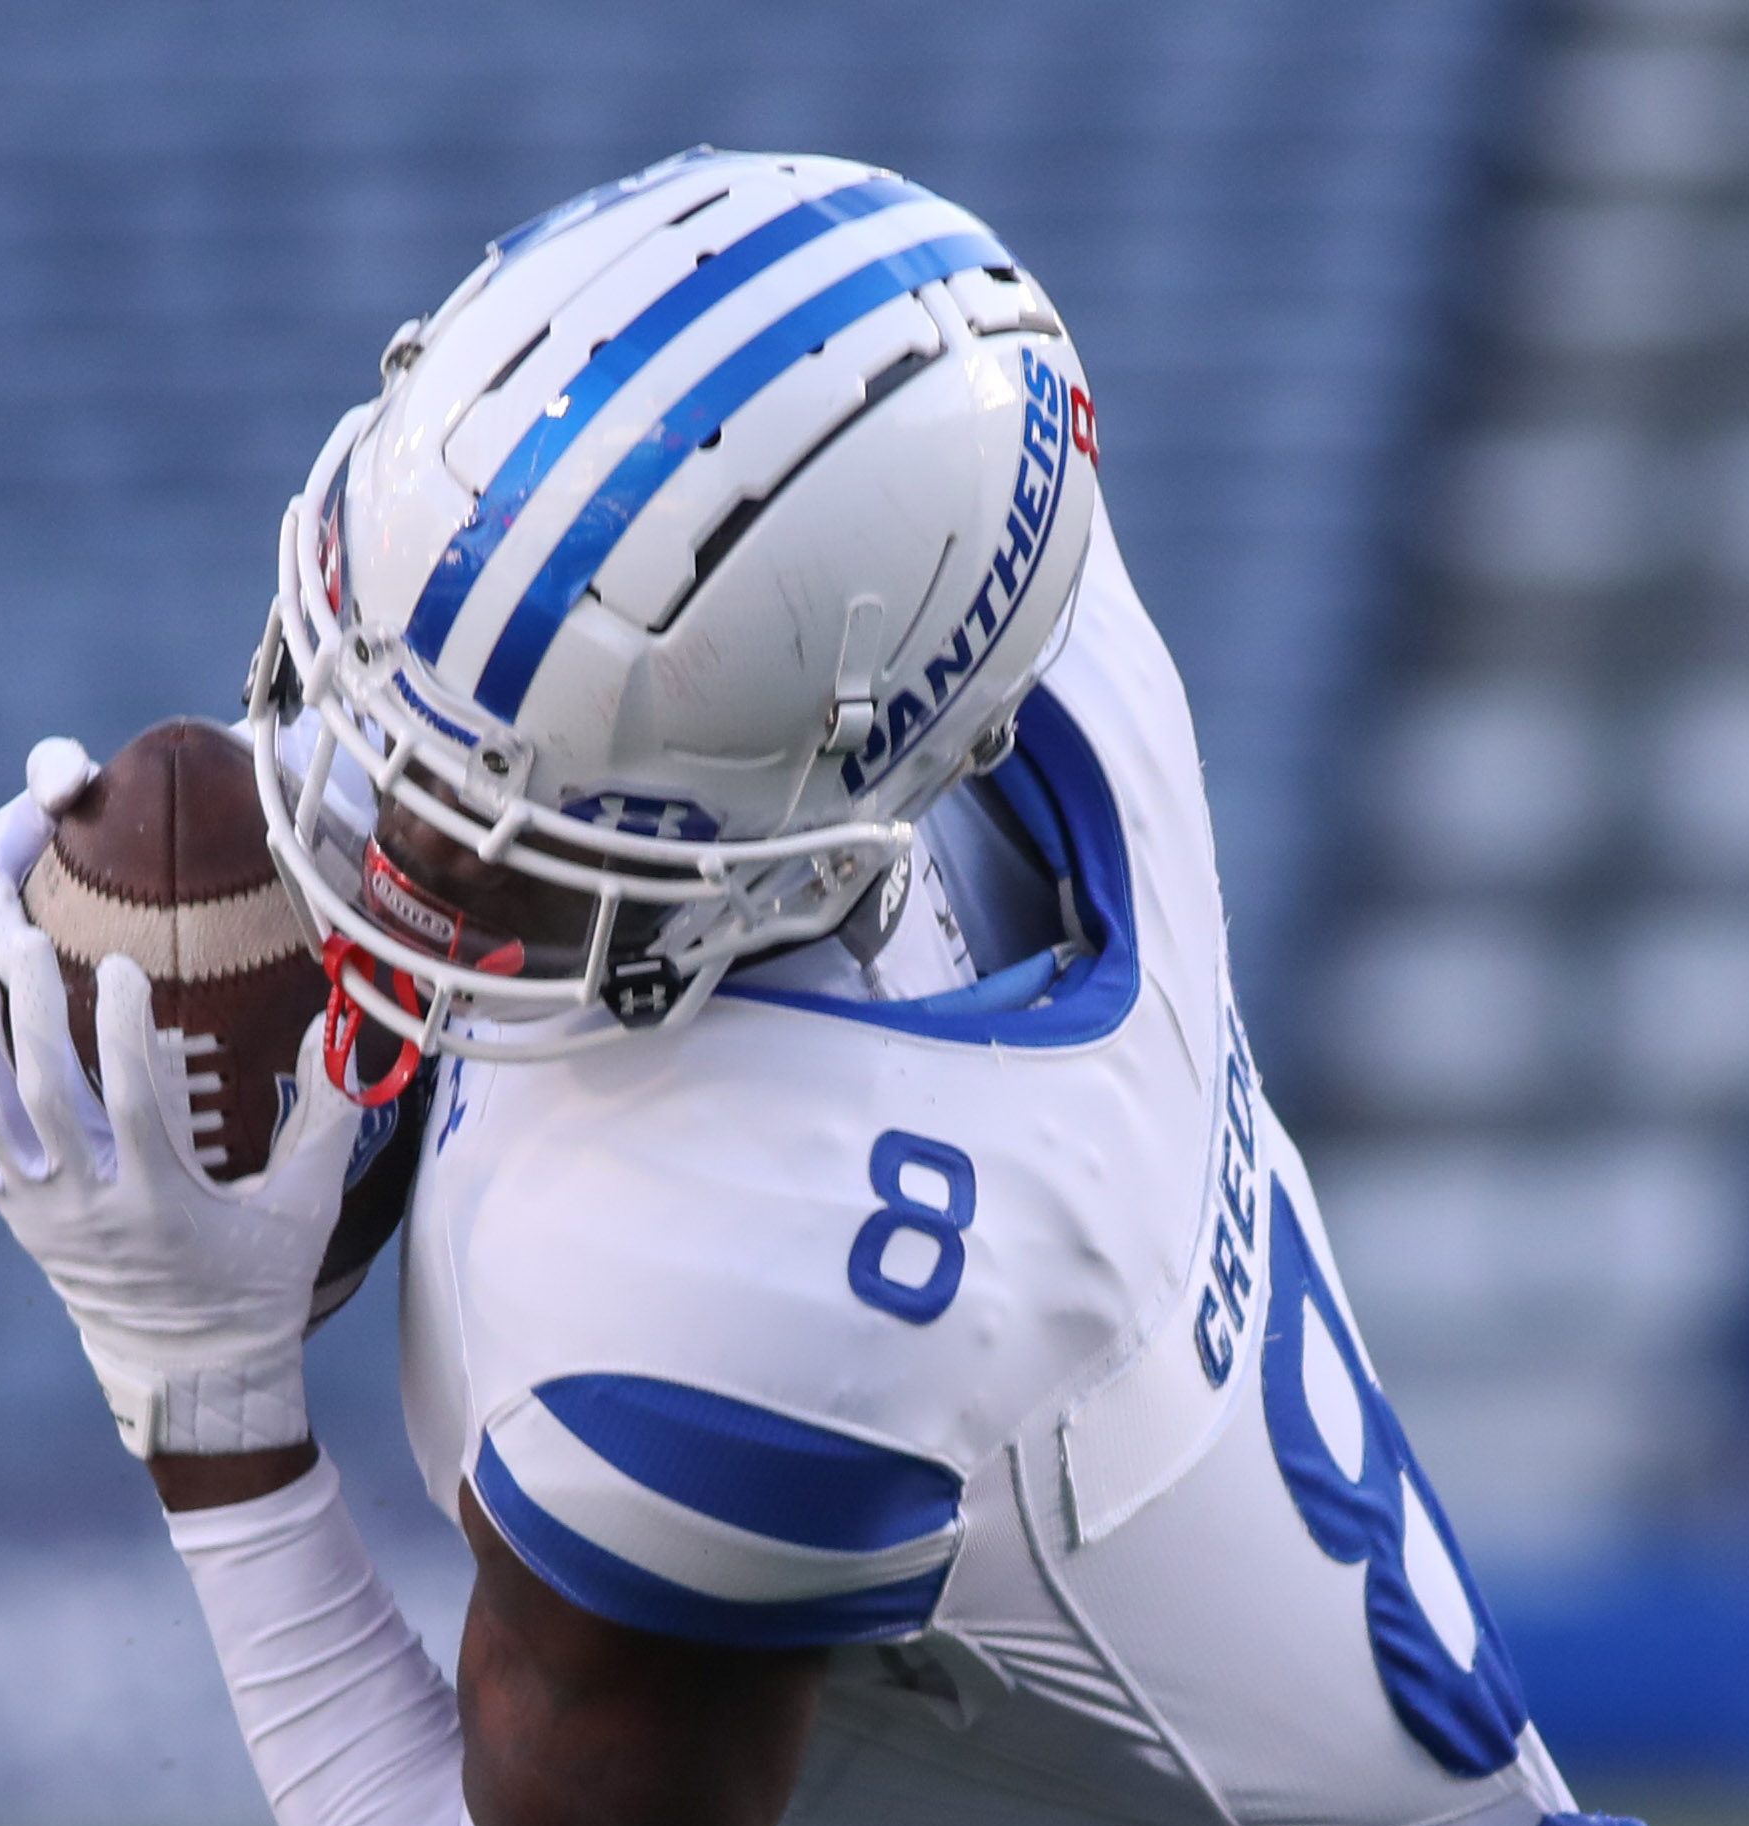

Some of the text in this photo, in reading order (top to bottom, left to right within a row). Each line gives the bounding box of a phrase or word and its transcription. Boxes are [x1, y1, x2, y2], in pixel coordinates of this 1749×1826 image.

[840, 346, 1059, 796] PANTHERS
[847, 1128, 977, 1326] 8
[1260, 1167, 1527, 1779] 8
